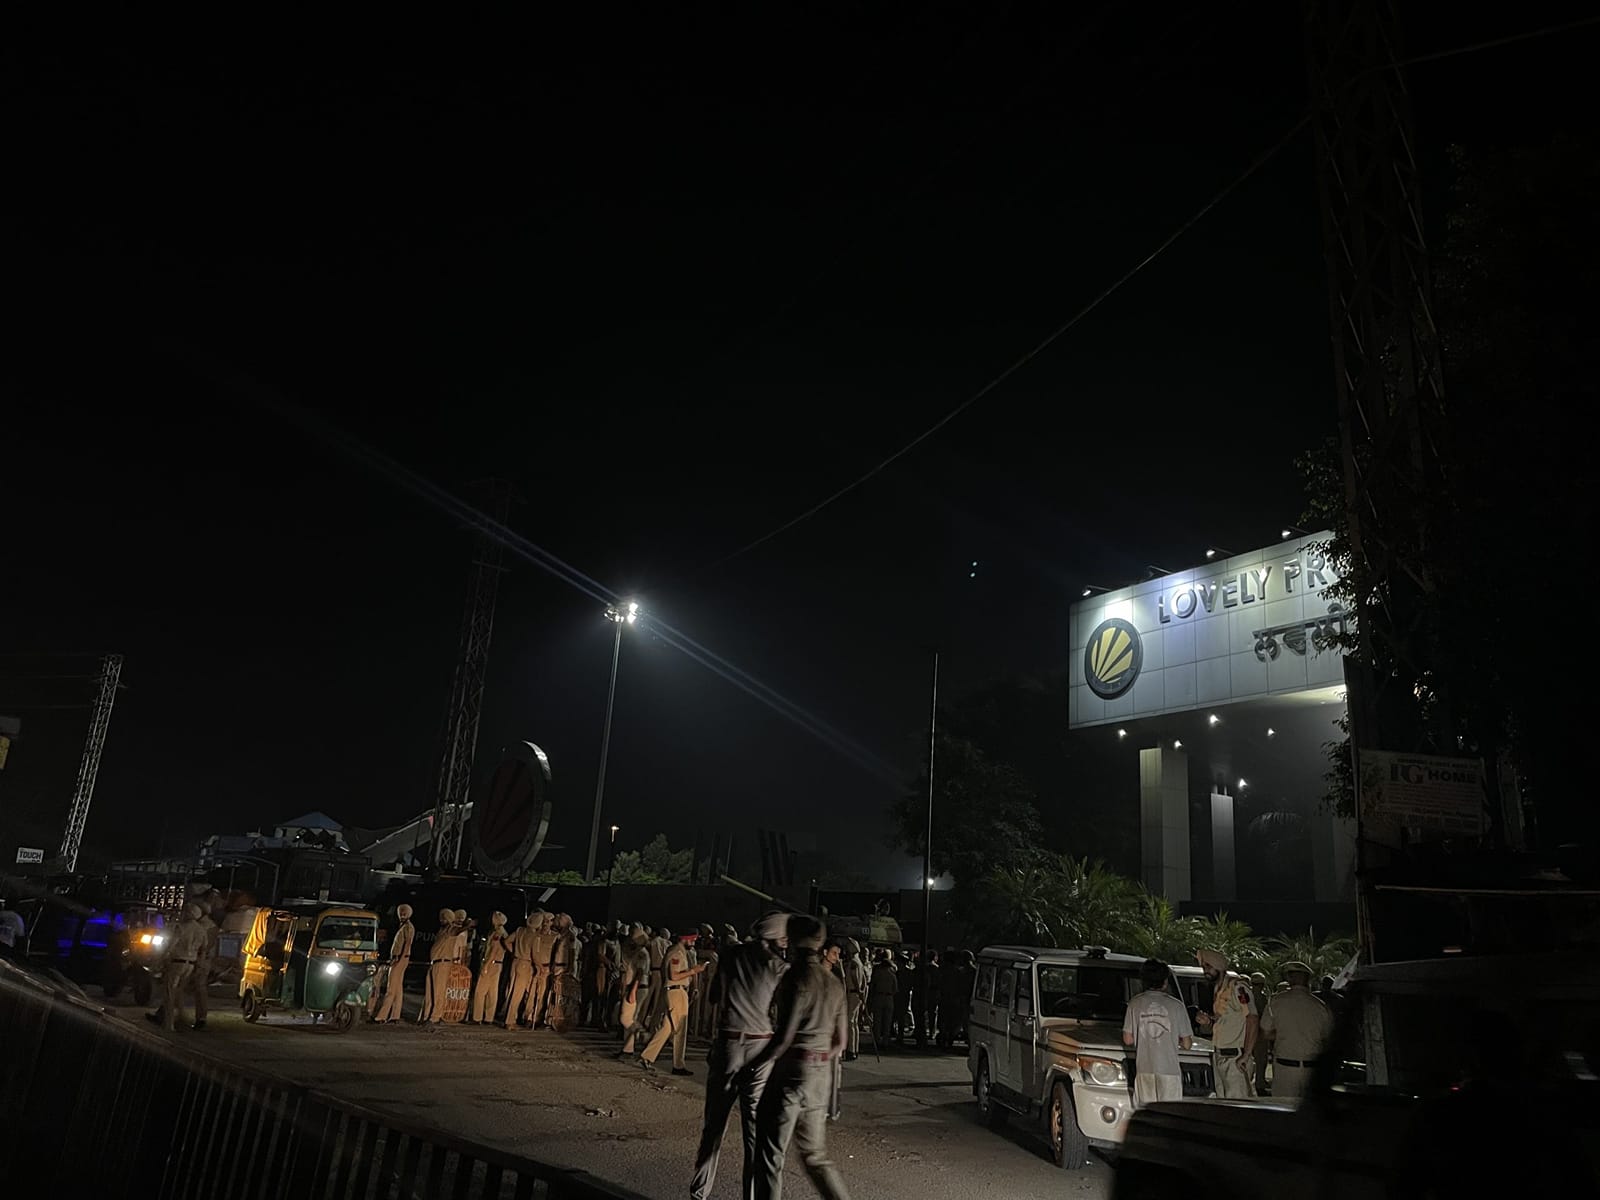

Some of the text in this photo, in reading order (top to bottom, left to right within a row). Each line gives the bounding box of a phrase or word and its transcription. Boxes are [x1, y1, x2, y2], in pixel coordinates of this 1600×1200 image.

[1158, 565, 1273, 625] LOVELY
[1428, 769, 1477, 784] HOME
[19, 850, 42, 860] TOUCH
